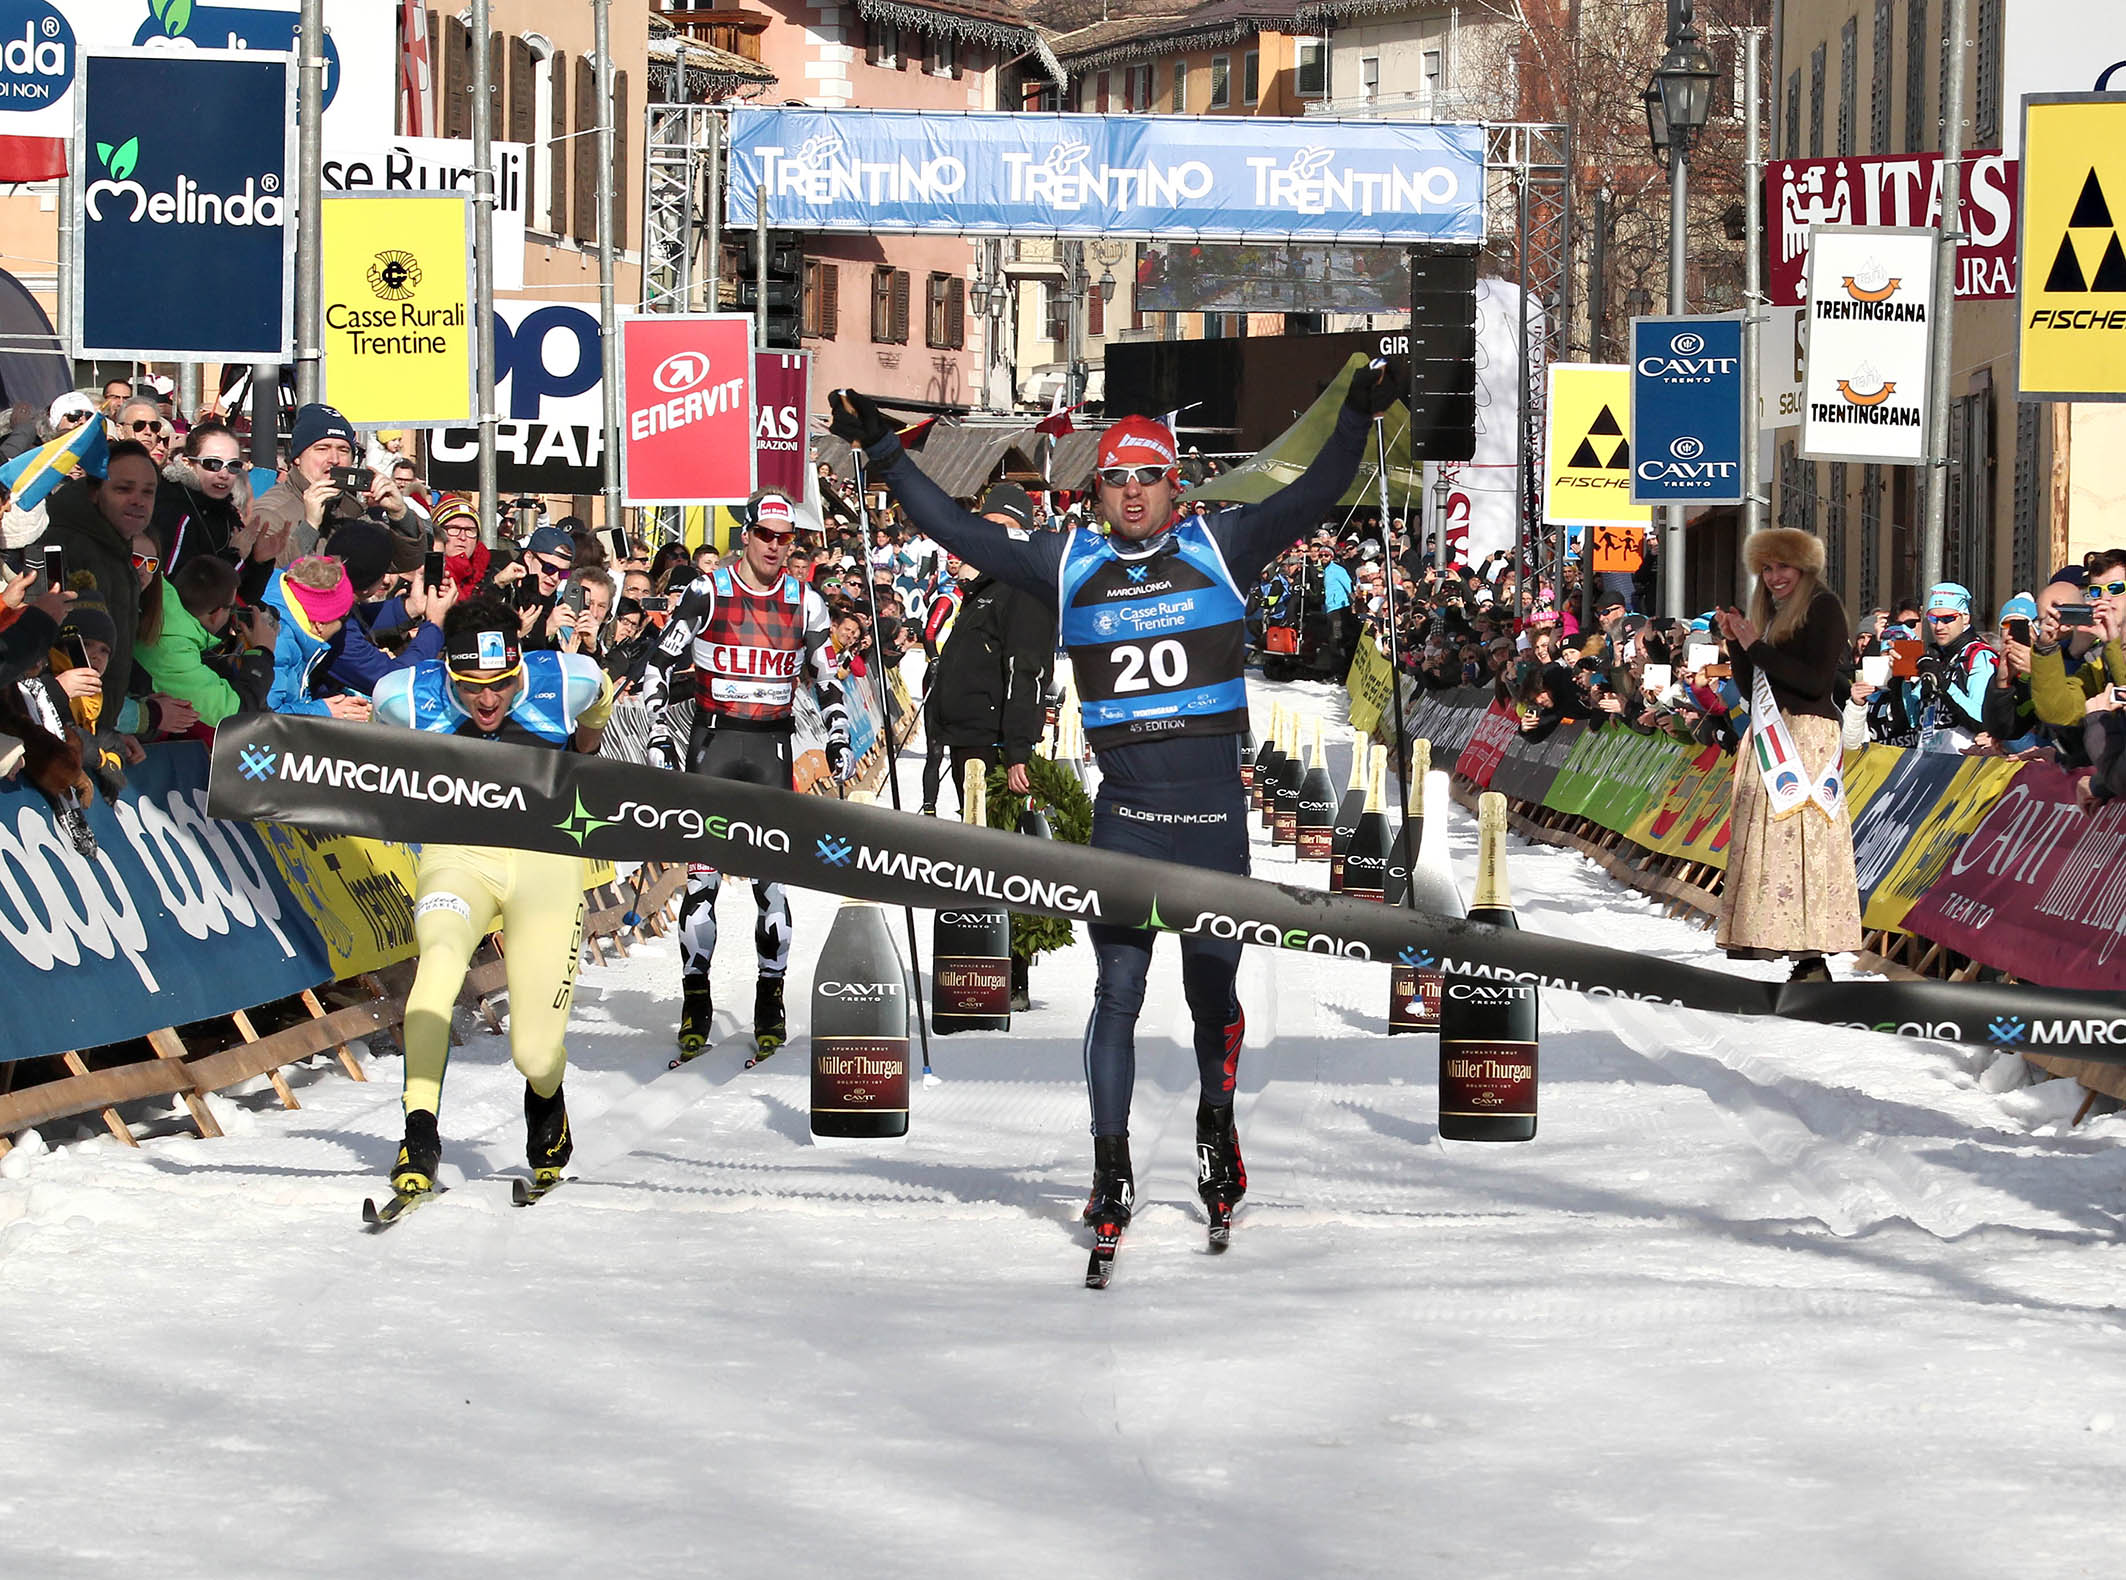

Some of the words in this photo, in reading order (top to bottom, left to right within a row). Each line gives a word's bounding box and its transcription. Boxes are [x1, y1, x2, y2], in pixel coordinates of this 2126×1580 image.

[13, 83, 49, 98] NON
[755, 146, 966, 206] TRENTINO
[1003, 153, 1213, 212] TRENTINO
[1247, 157, 1458, 216] TRENTINO
[326, 304, 396, 329] Casse
[402, 303, 464, 326] Rurali
[1816, 300, 1926, 322] TRENTINGRANA
[346, 331, 446, 354] Trentine
[1637, 356, 1737, 377] CAVIT
[631, 380, 743, 442] ENERVIT
[755, 404, 800, 440] AS
[1811, 403, 1921, 427] TRENTINGRANA
[1637, 461, 1737, 481] CAVIT
[1106, 580, 1172, 598] MARCIALONGA
[1119, 602, 1157, 621] Casse
[1158, 598, 1194, 616] Rurali
[1131, 614, 1185, 631] Trentine
[1110, 639, 1189, 693] 20
[1145, 720, 1185, 731] EDITION
[280, 752, 527, 811] MARCIALONGA
[1298, 801, 1337, 809] CAVIT
[608, 801, 791, 853] sorgenia
[1951, 783, 2084, 884] CAVIT
[856, 846, 1102, 916] MARCIALONGA
[940, 912, 1008, 924] CAVIT
[1939, 893, 1995, 929] TRENTO
[818, 982, 903, 997] CAVIT
[967, 971, 1006, 990] Thurgau
[1449, 984, 1532, 1000] CAVIT
[854, 1056, 903, 1079] Thurgau
[1483, 1059, 1532, 1083] Thurgau
